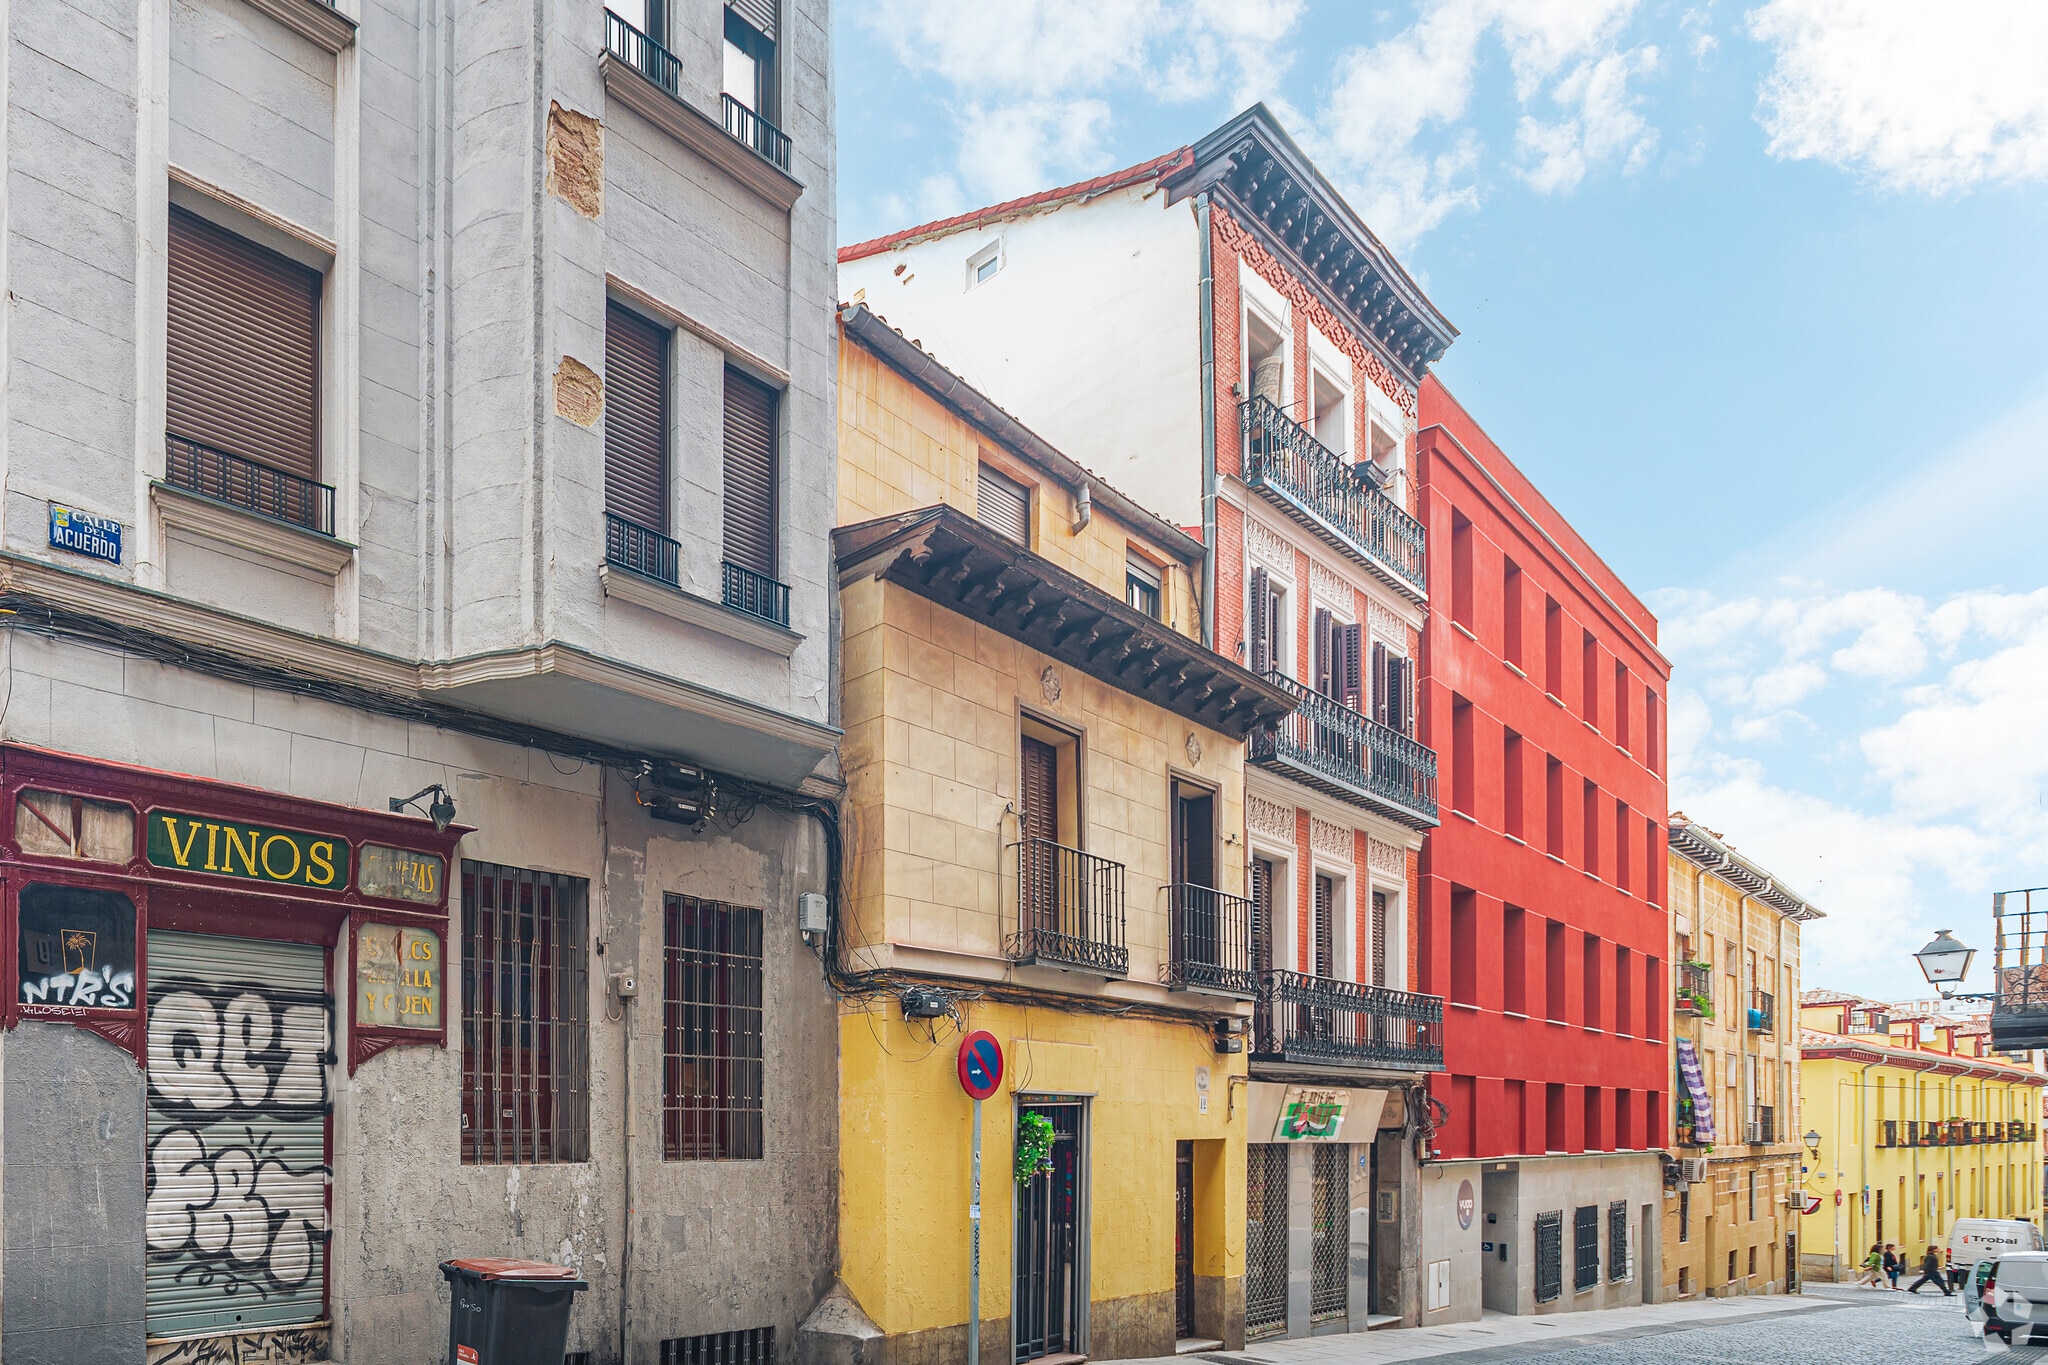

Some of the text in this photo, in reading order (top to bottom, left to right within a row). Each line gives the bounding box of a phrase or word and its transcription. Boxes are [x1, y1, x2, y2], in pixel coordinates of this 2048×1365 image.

[72, 512, 119, 534] CALLE
[84, 526, 107, 539] DEL
[55, 527, 117, 560] ACUERDO
[162, 816, 335, 885] VINOS
[1971, 1235, 2018, 1245] Trobal
